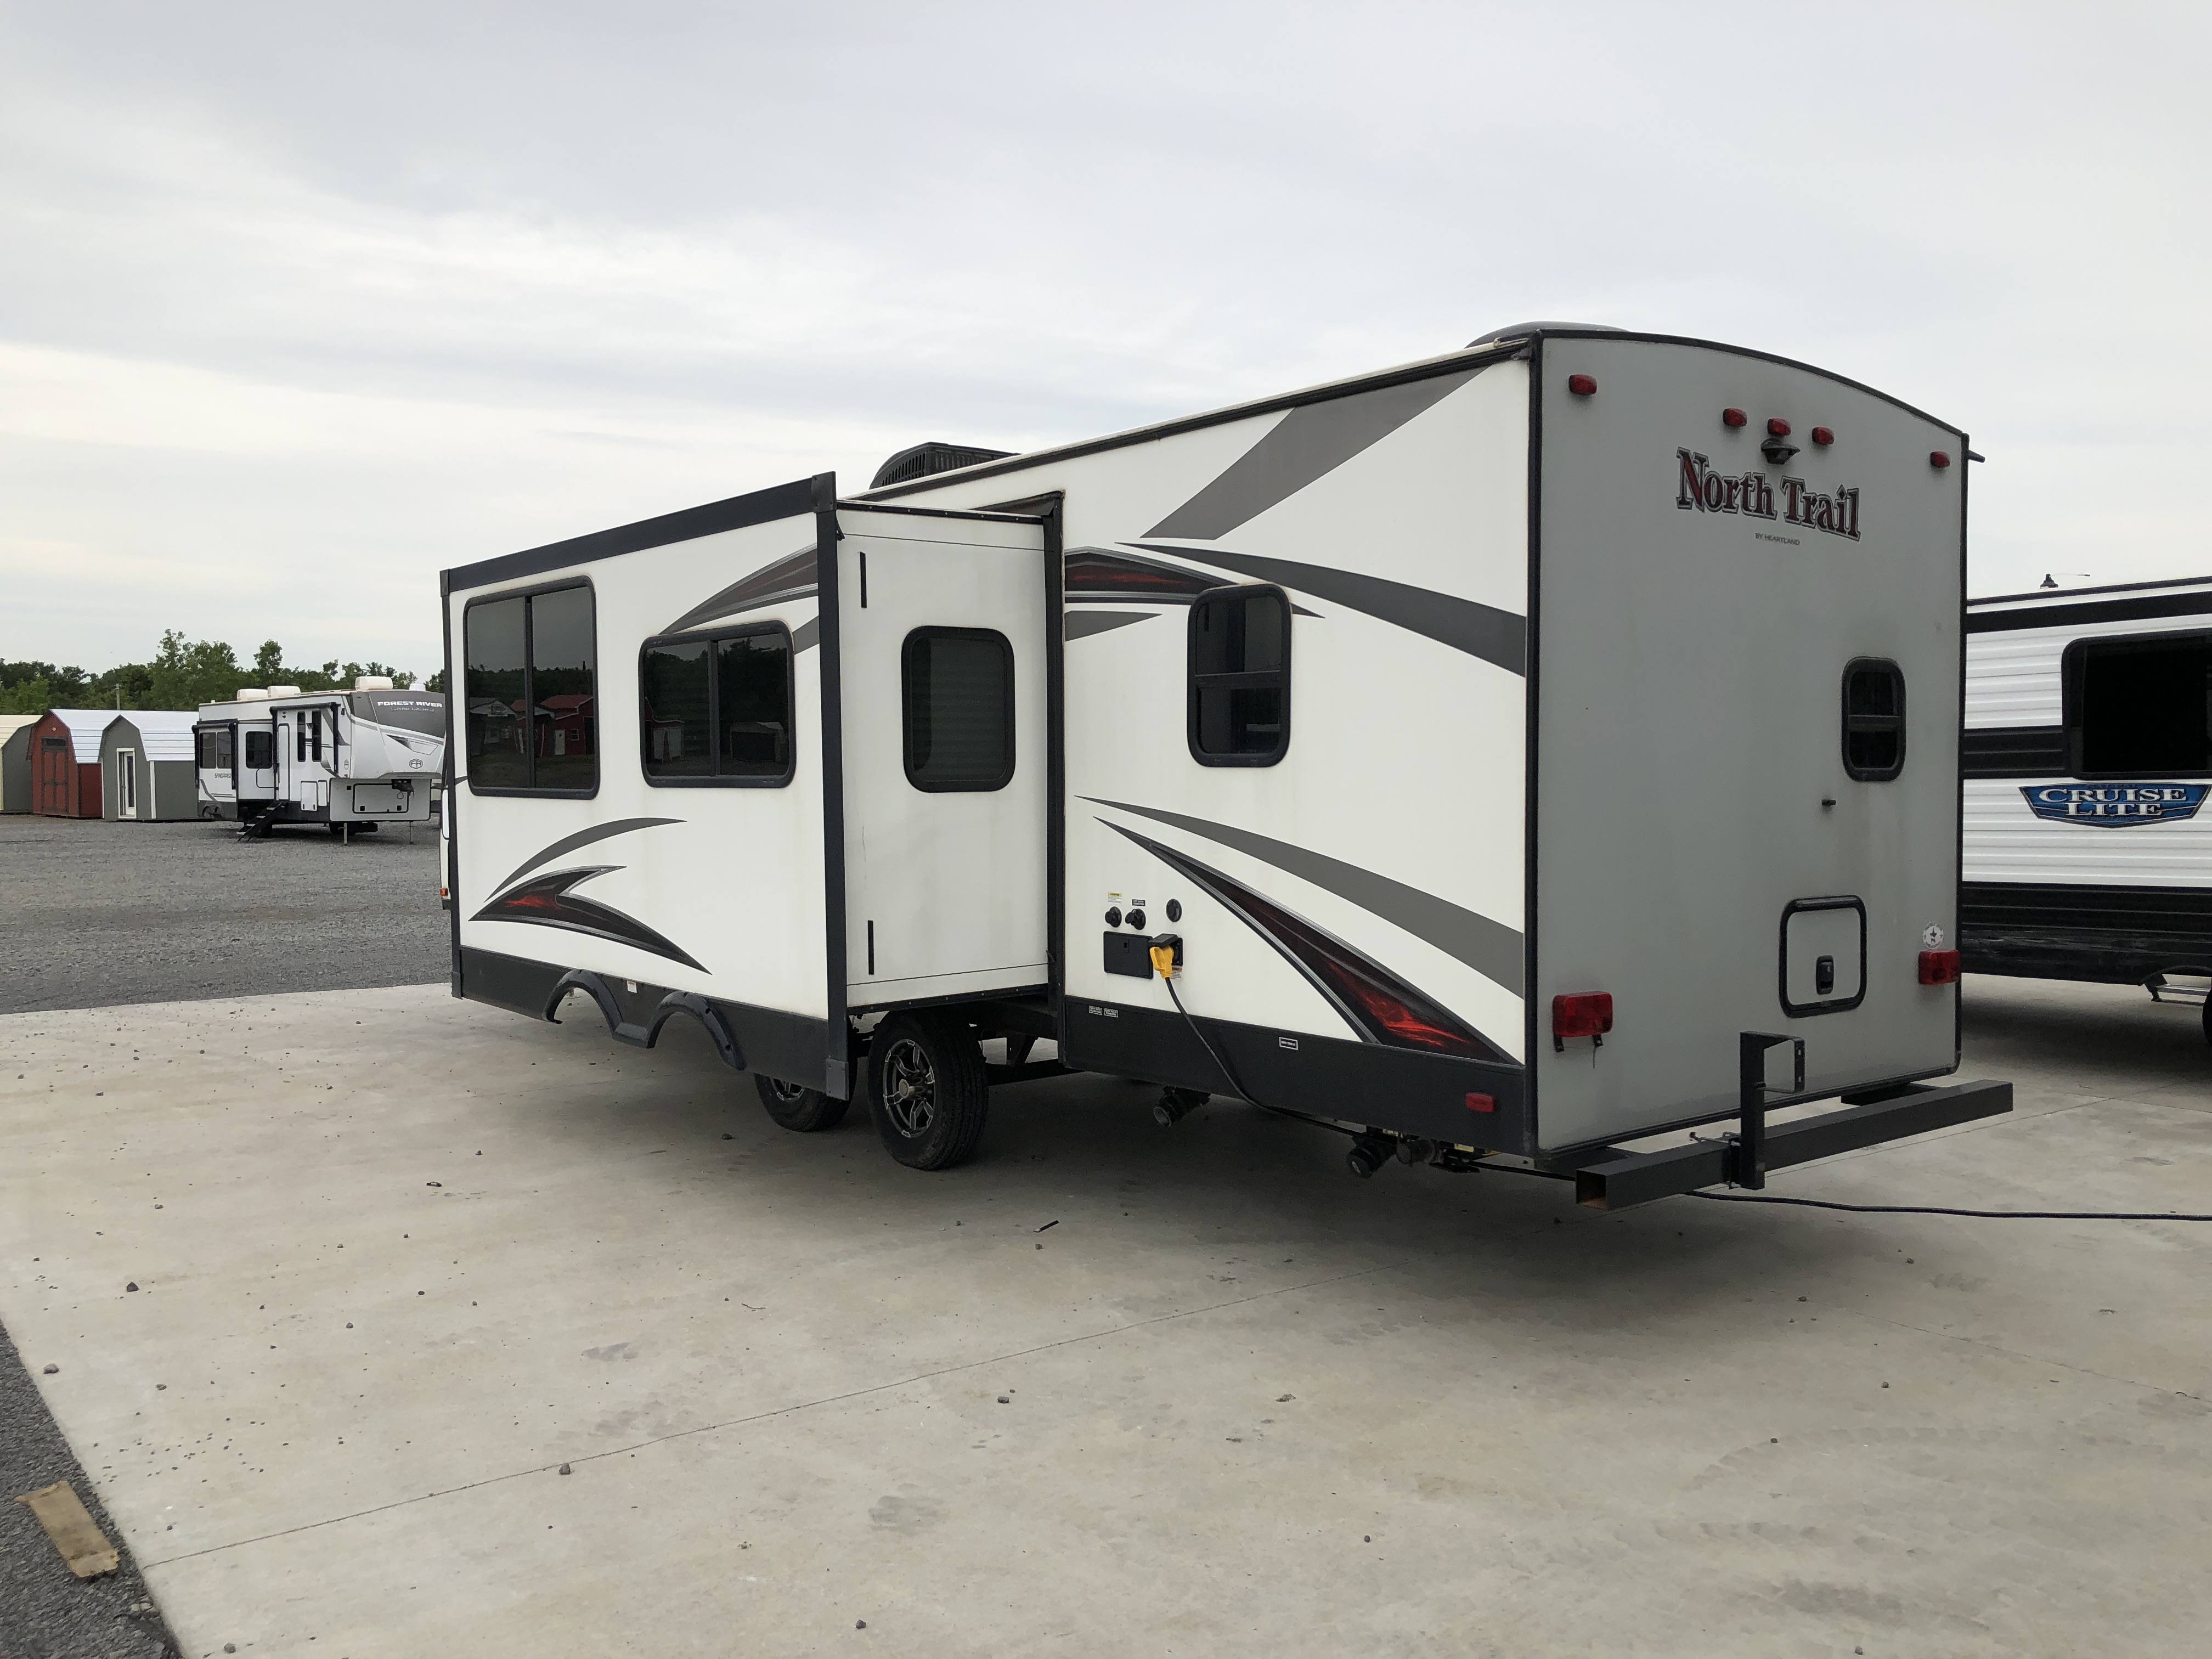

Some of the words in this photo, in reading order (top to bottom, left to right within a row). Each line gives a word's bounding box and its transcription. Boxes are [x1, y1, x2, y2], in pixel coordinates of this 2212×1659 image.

[1676, 447, 1778, 521] North
[1780, 476, 1861, 541] Trail
[1764, 534, 1801, 545] HEARTLAND
[2038, 788, 2187, 803] CRUISE
[2065, 802, 2162, 816] LITE
